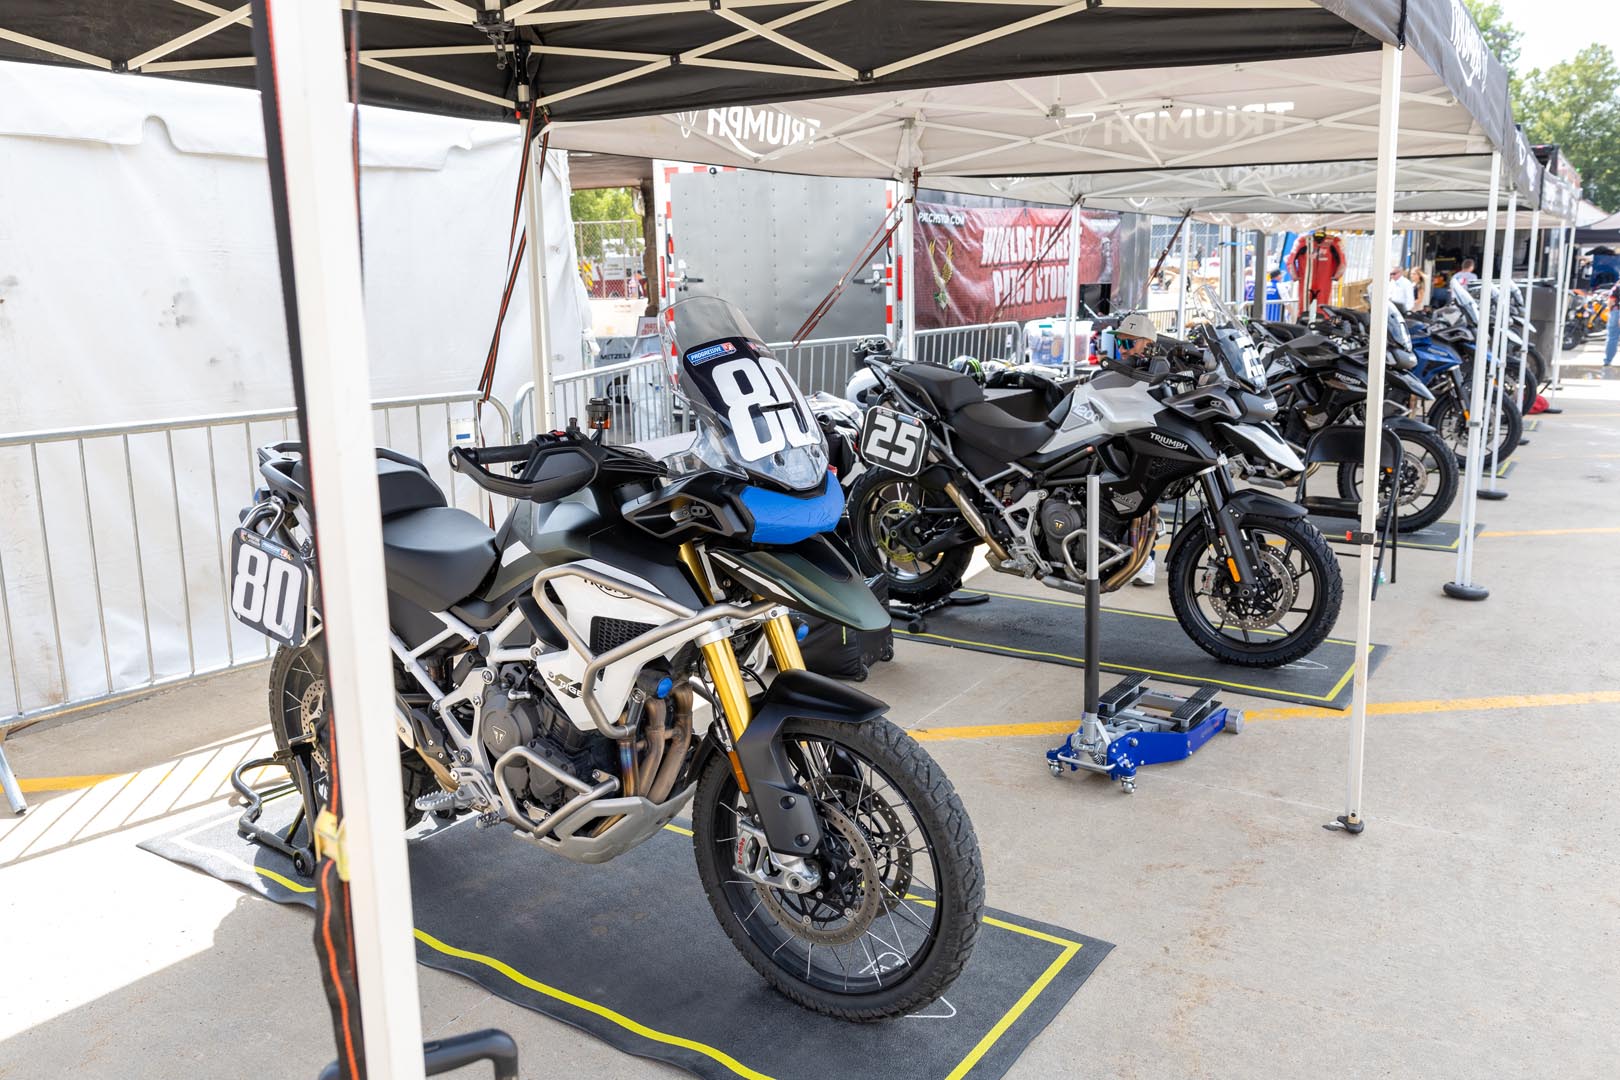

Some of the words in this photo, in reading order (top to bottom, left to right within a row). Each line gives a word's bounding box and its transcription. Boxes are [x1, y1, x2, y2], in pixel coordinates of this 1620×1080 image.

[980, 226, 1033, 265] WORLDS
[1033, 225, 1082, 263] LARGE
[992, 267, 1034, 307] PATCH
[690, 346, 722, 361] PROGRESSIVE
[711, 357, 821, 462] 80
[865, 414, 922, 467] 25
[1150, 431, 1188, 451] TRIUMPH
[232, 543, 302, 639] 80
[557, 677, 583, 698] TIGE
